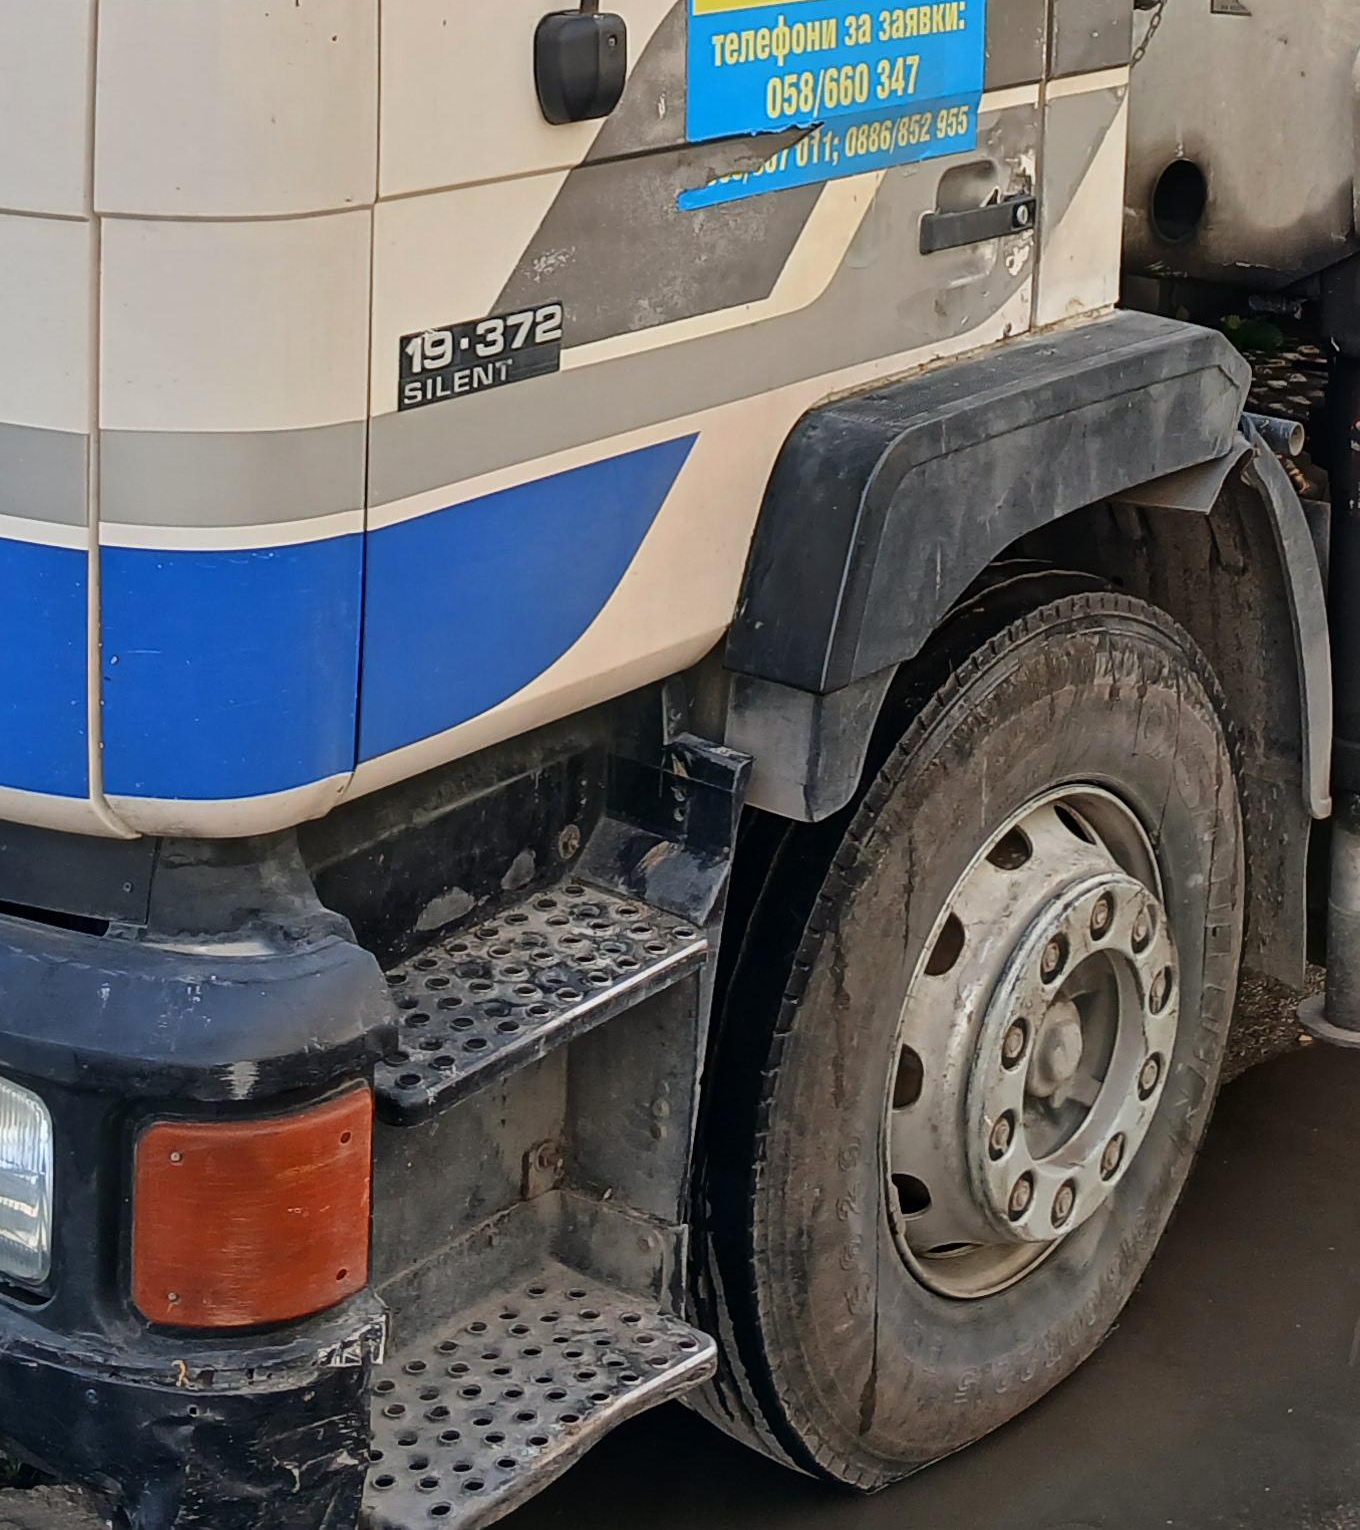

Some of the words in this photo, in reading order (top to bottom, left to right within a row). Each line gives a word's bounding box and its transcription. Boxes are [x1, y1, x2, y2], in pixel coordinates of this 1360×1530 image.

[711, 15, 837, 67] телефони
[844, 14, 872, 46] за
[878, 0, 967, 42] заявки:
[766, 63, 870, 119] 058/660
[876, 55, 921, 101] 347
[845, 112, 931, 156] 0886/852
[935, 105, 969, 139] 955
[403, 358, 513, 405] SILENT
